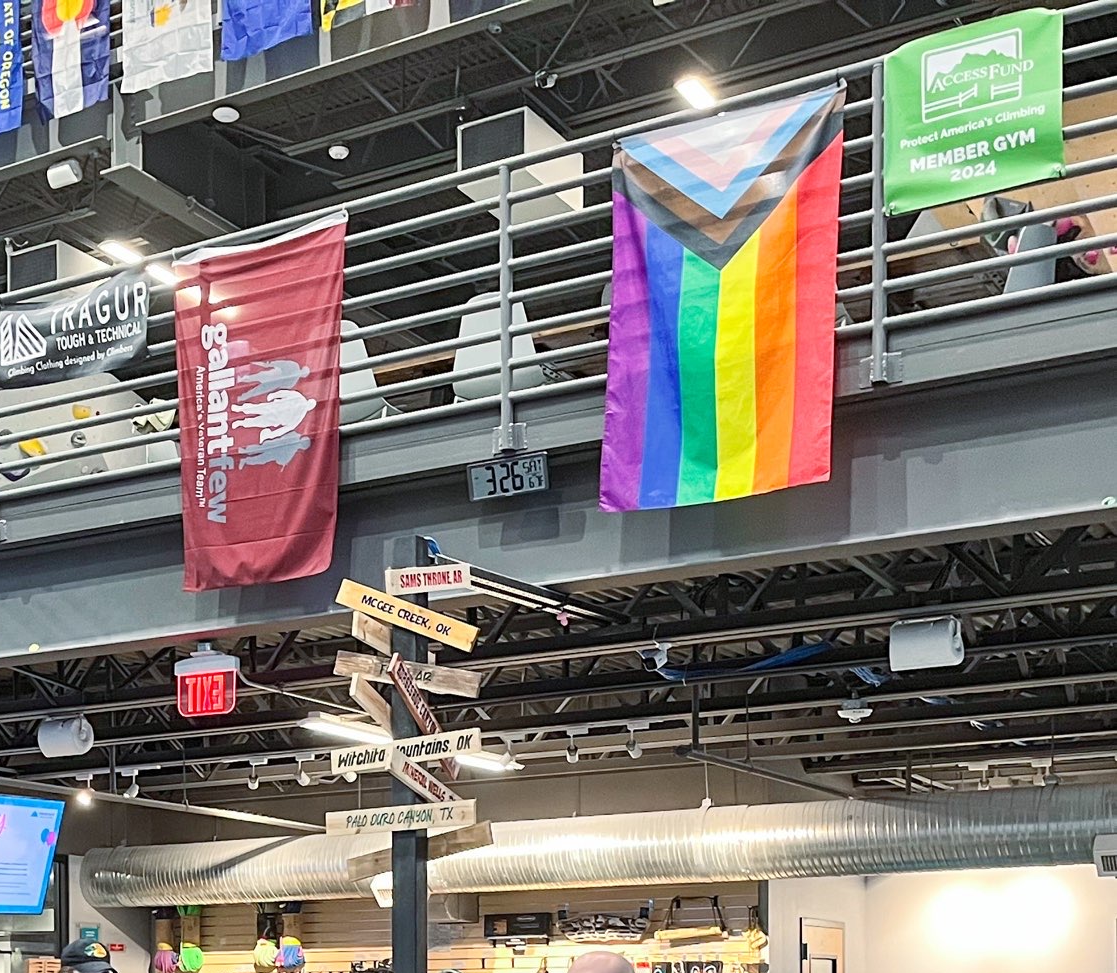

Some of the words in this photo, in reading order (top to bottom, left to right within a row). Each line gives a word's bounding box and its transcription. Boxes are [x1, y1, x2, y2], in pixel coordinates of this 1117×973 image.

[3, 2, 14, 27] ATE
[3, 29, 15, 46] OF
[900, 129, 938, 150] Protect
[940, 117, 993, 139] America's
[994, 103, 1046, 123] Climbing
[909, 140, 990, 173] MEMBER
[993, 127, 1036, 152] GYM
[949, 160, 997, 183] 2024
[56, 332, 86, 351] TOUGH
[87, 335, 94, 345] &
[95, 321, 142, 344] TECHNICAL
[7, 364, 35, 380] Climbing
[35, 358, 64, 373] Clothing
[64, 352, 96, 367] designed
[96, 349, 105, 361] by
[106, 344, 133, 358] Climbers
[195, 365, 206, 423] America's
[201, 322, 236, 524] gallantfew
[195, 424, 206, 469] Veteran
[400, 572, 422, 588] SAMS
[453, 570, 462, 583] AR
[361, 595, 395, 615] MCGEE
[397, 609, 431, 630] CREEK,
[435, 623, 451, 636] OK
[338, 748, 386, 768] Witchita
[456, 734, 473, 751] OK
[346, 813, 367, 829] PALO
[370, 812, 395, 827] DURO
[440, 807, 453, 820] TX
